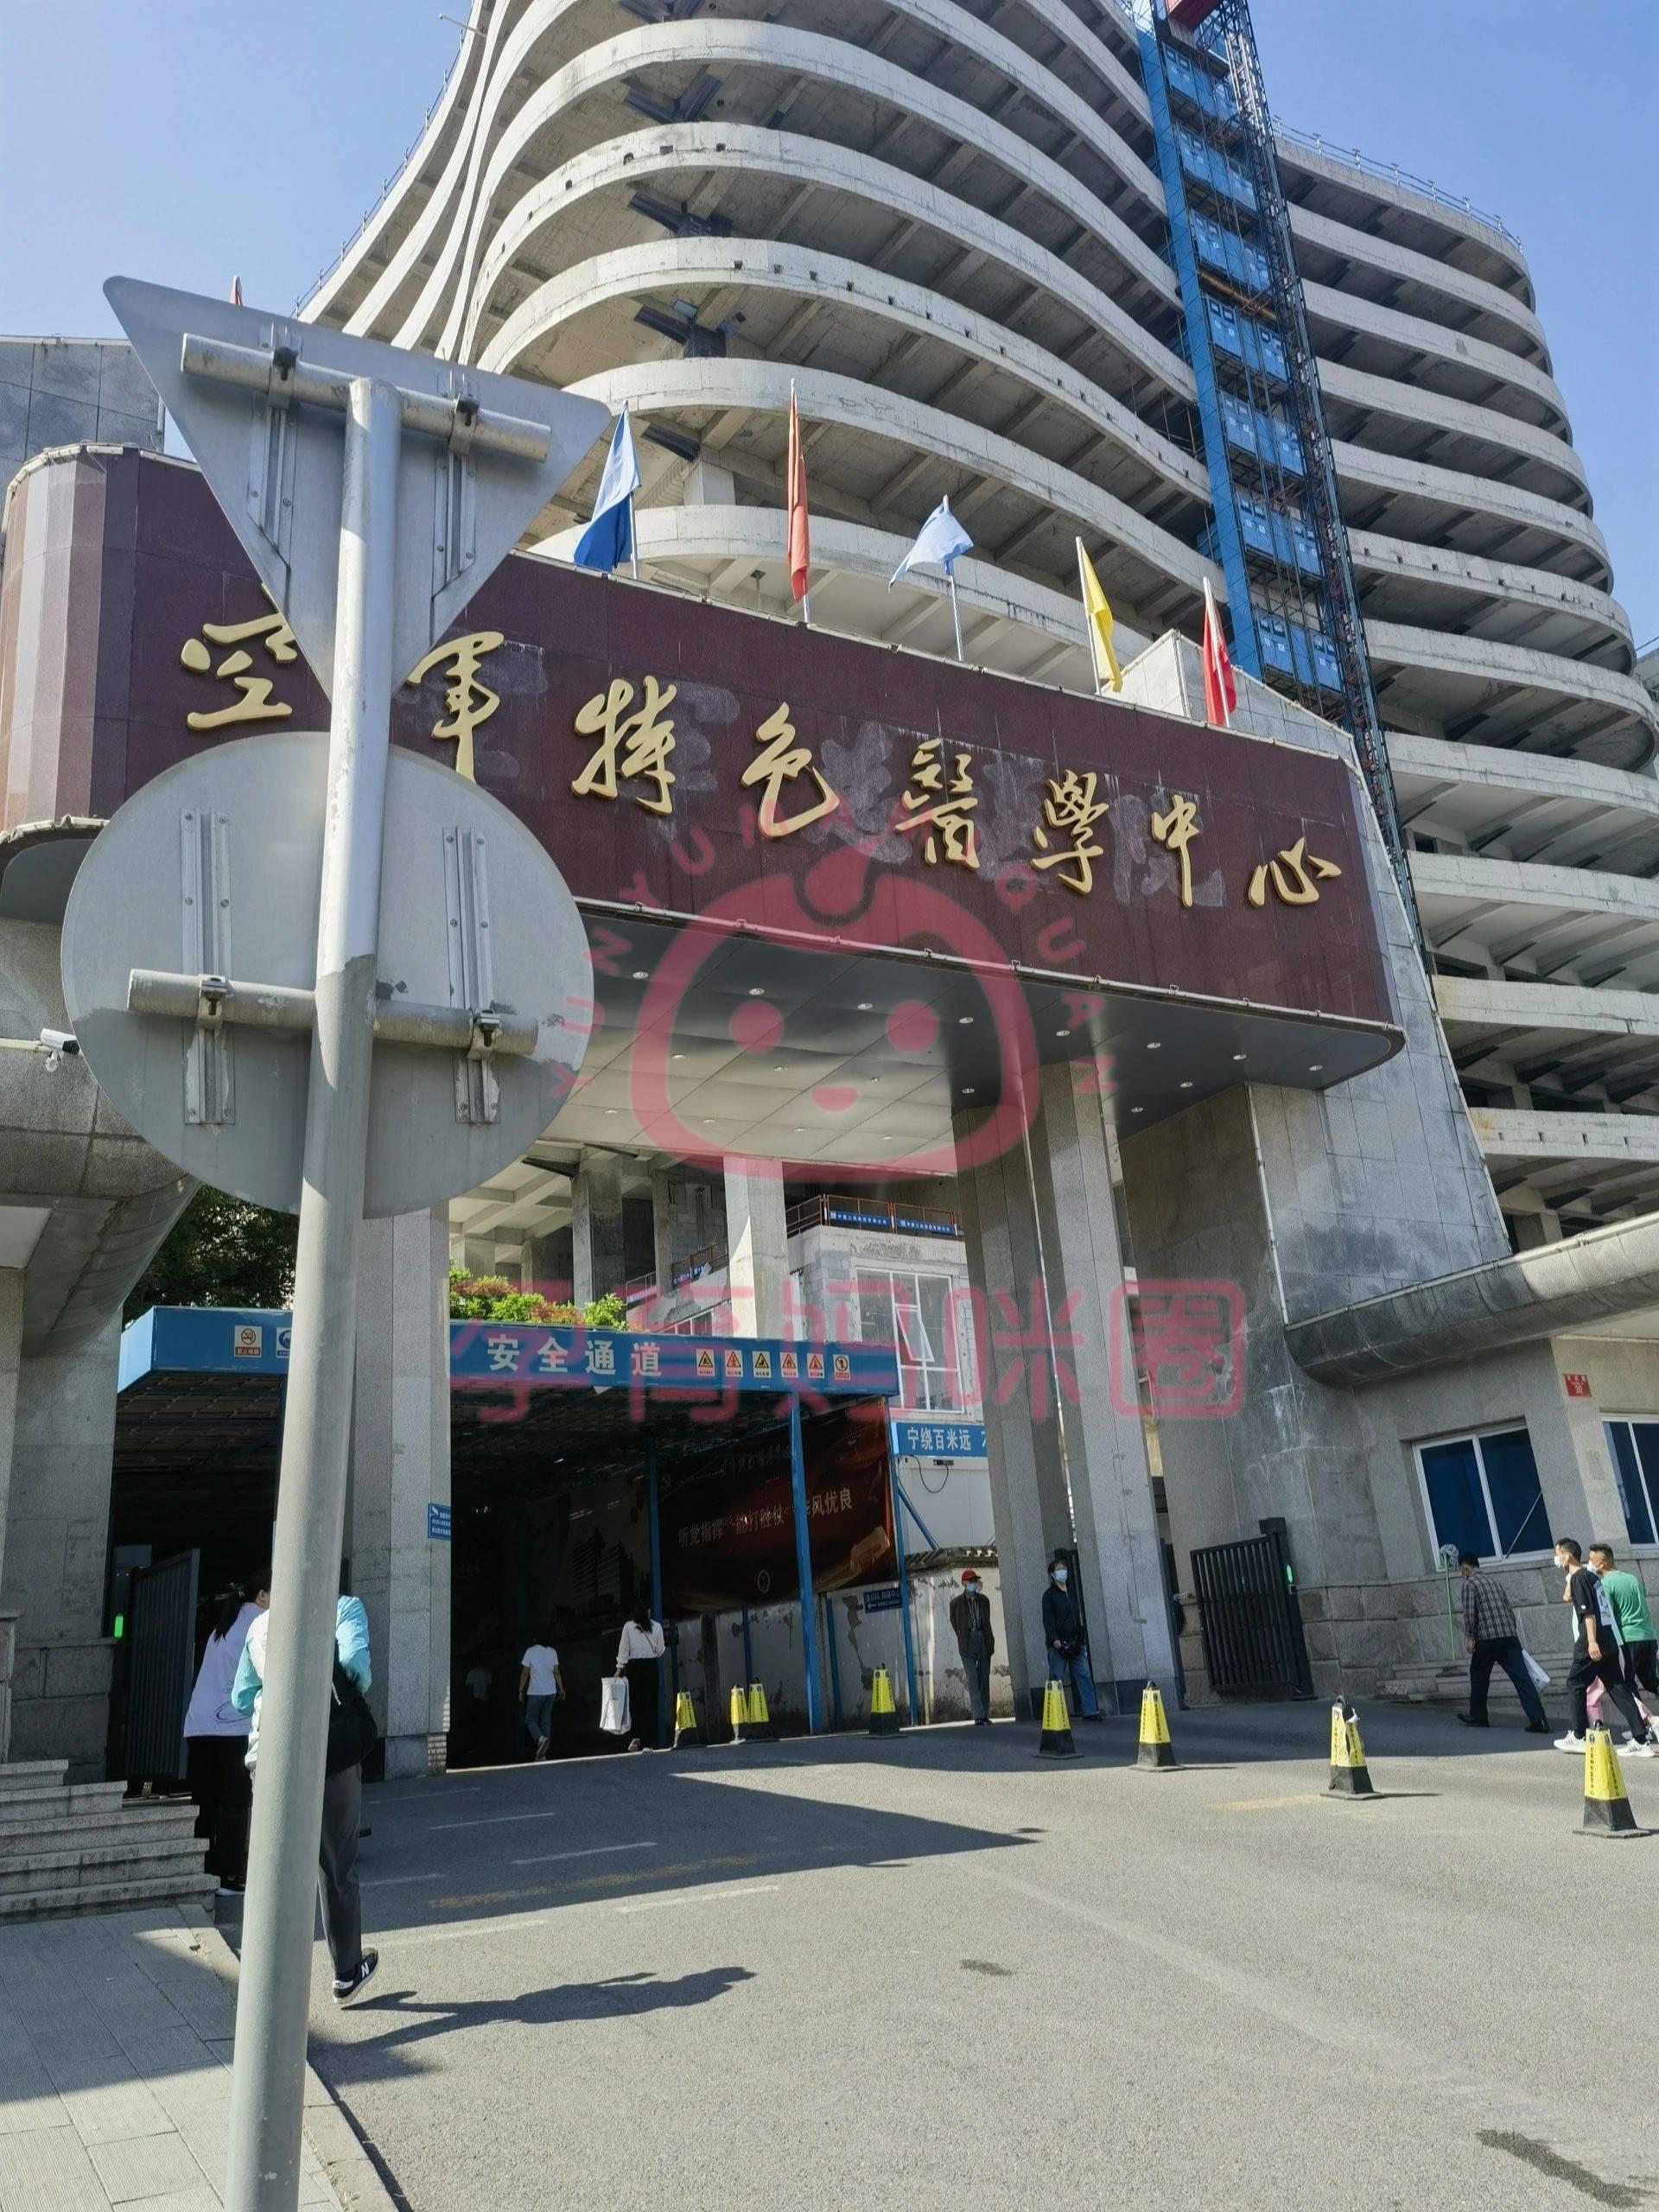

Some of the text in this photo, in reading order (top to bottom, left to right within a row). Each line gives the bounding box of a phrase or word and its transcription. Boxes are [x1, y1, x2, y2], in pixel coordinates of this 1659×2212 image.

[486, 1333, 663, 1377] 安全通道
[906, 1427, 972, 1451] 宁绕百米远
